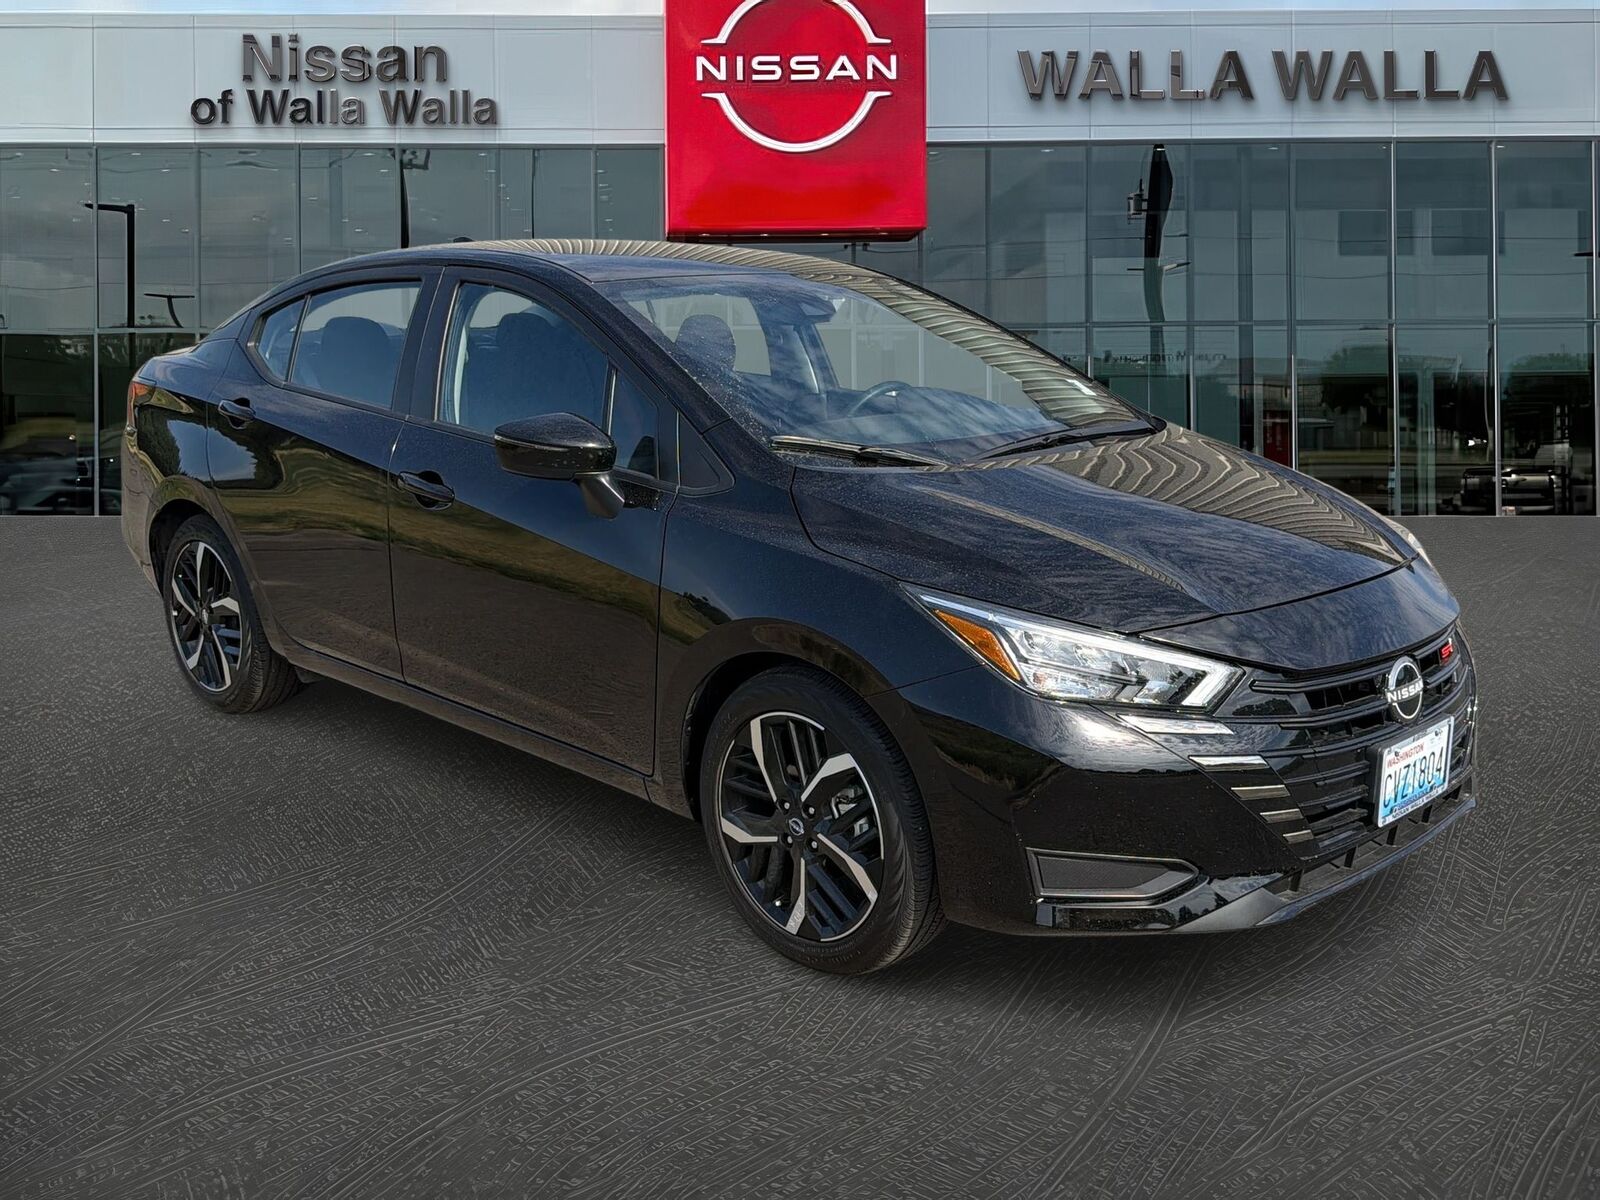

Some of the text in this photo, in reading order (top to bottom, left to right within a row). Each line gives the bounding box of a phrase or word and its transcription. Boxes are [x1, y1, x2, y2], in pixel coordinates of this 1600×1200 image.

[241, 33, 448, 83] Nissan
[696, 54, 897, 81] NISSAN
[1017, 49, 1509, 101] WALLA WALLA
[190, 88, 499, 126] of Walla Walla
[1385, 679, 1424, 704] NISSAN
[1387, 742, 1425, 768] WASHINGTON
[1383, 747, 1444, 809] CVZ1804
